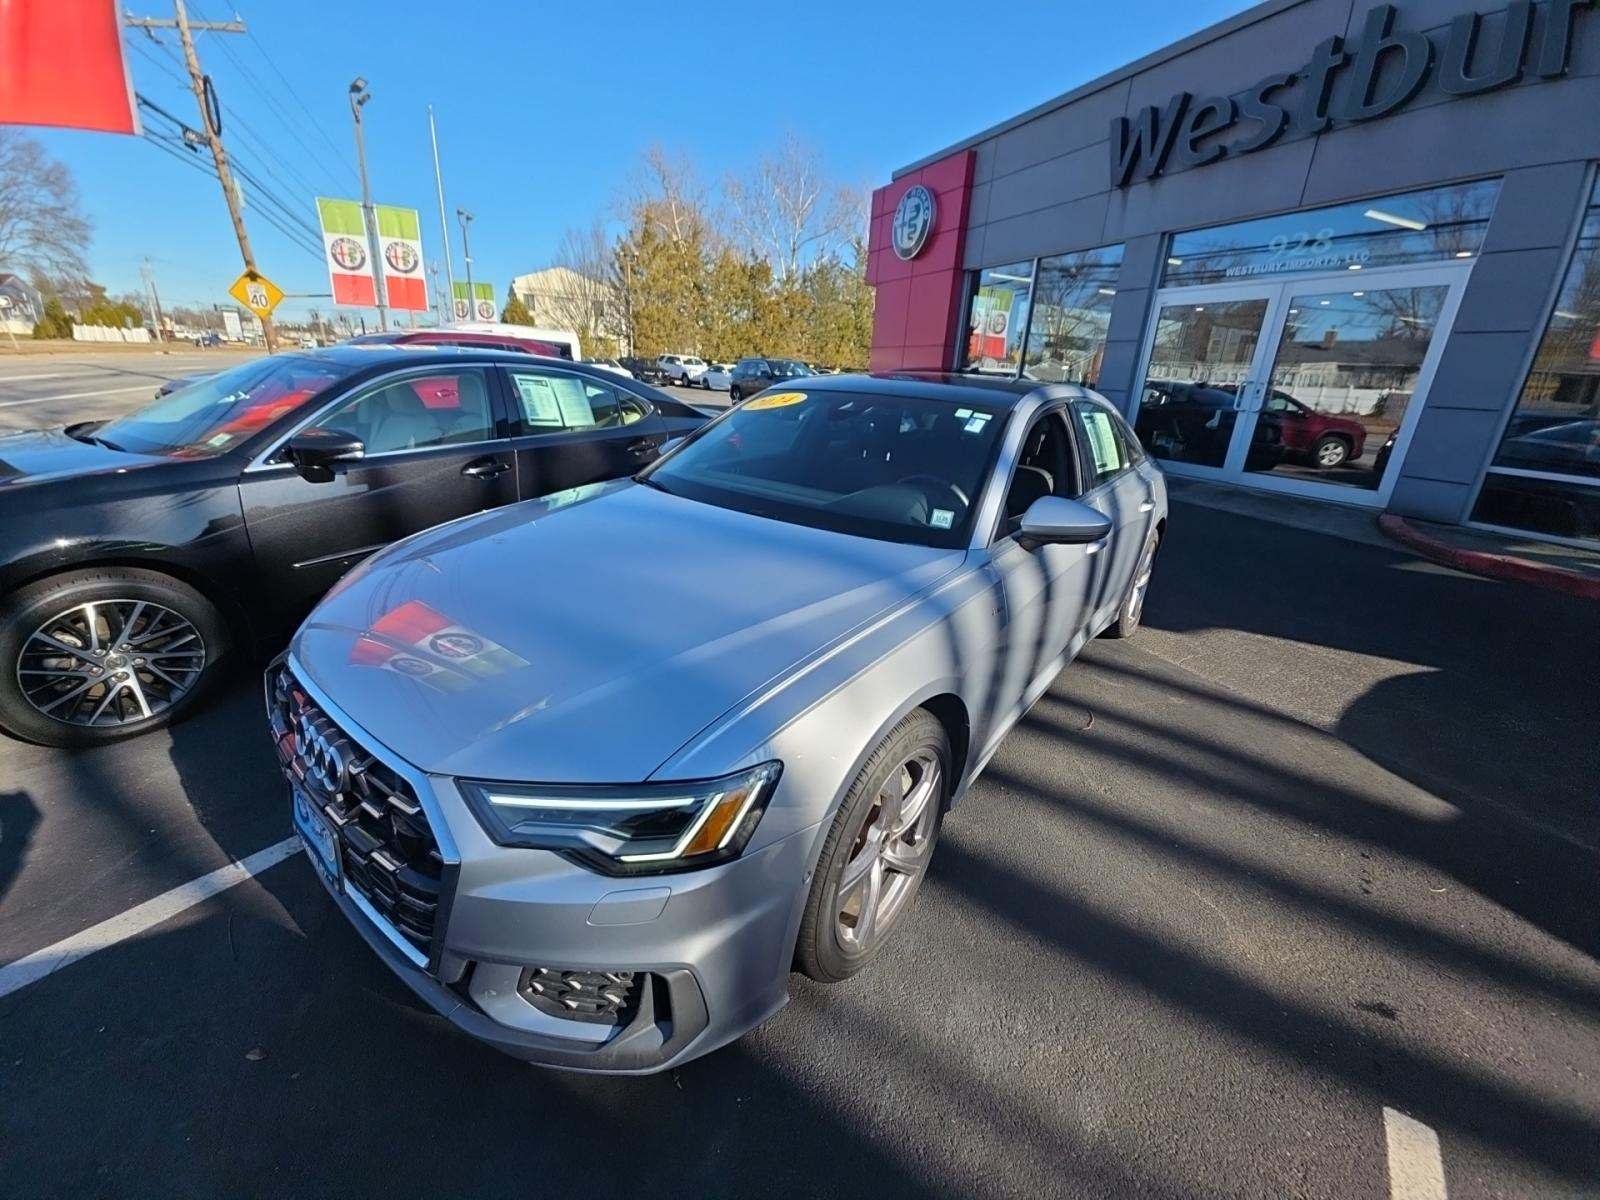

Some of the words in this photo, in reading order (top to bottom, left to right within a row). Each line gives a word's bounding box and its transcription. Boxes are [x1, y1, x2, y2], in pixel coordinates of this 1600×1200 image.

[1267, 228, 1334, 261] 928
[1226, 260, 1284, 277] WESTBURY
[251, 294, 268, 308] 40
